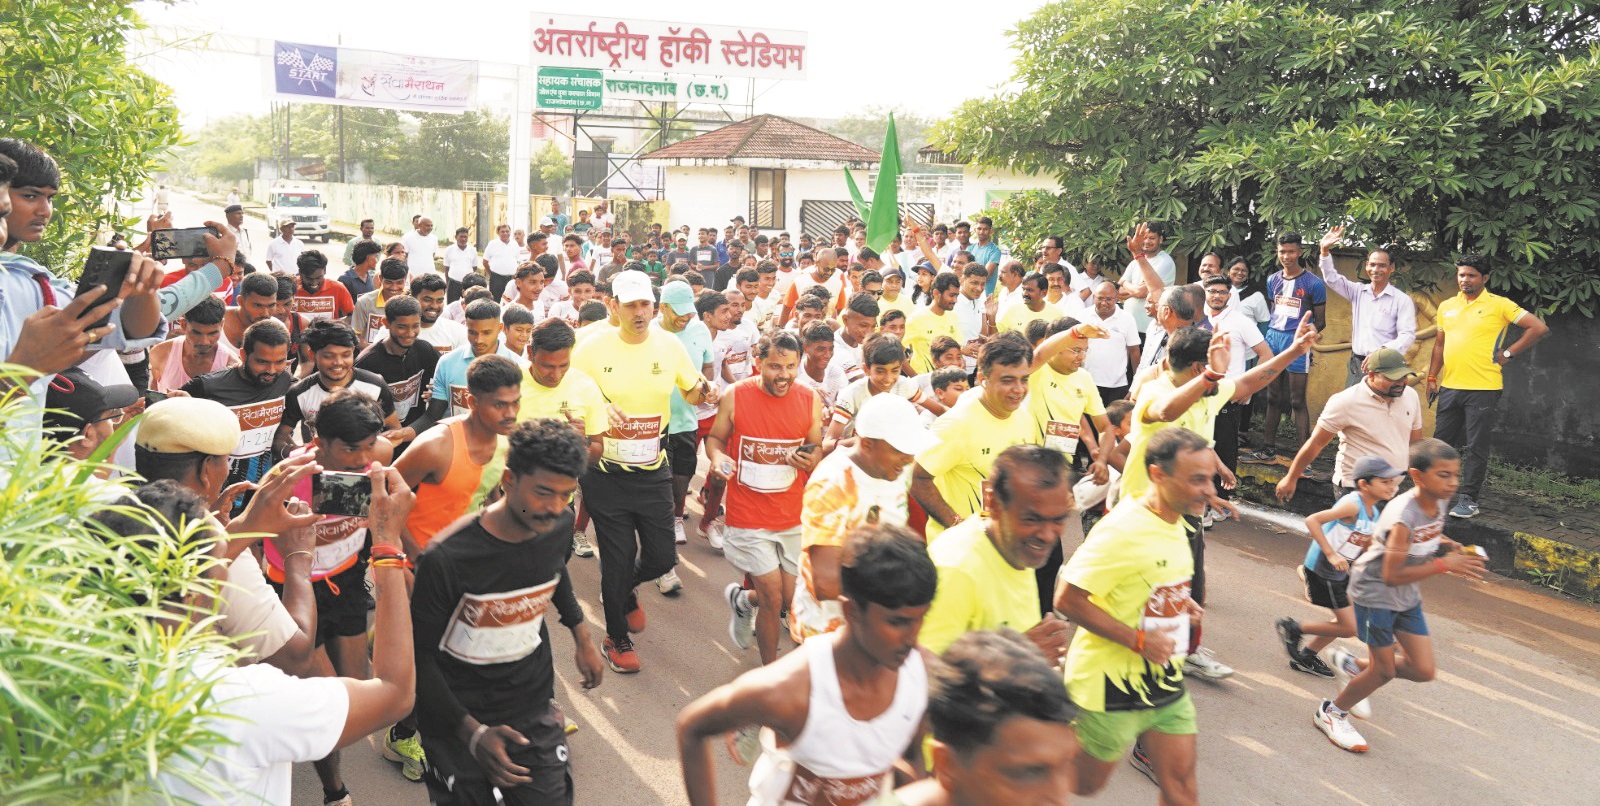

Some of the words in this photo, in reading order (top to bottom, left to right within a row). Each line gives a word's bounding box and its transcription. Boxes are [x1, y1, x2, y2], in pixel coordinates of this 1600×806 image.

[533, 18, 649, 67] अंतर्राष्ट्रीय
[658, 26, 712, 67] हॉकी
[720, 29, 805, 70] स्टेडियम
[289, 69, 328, 81] START
[538, 75, 569, 87] सहायक
[570, 73, 602, 87] संचालक
